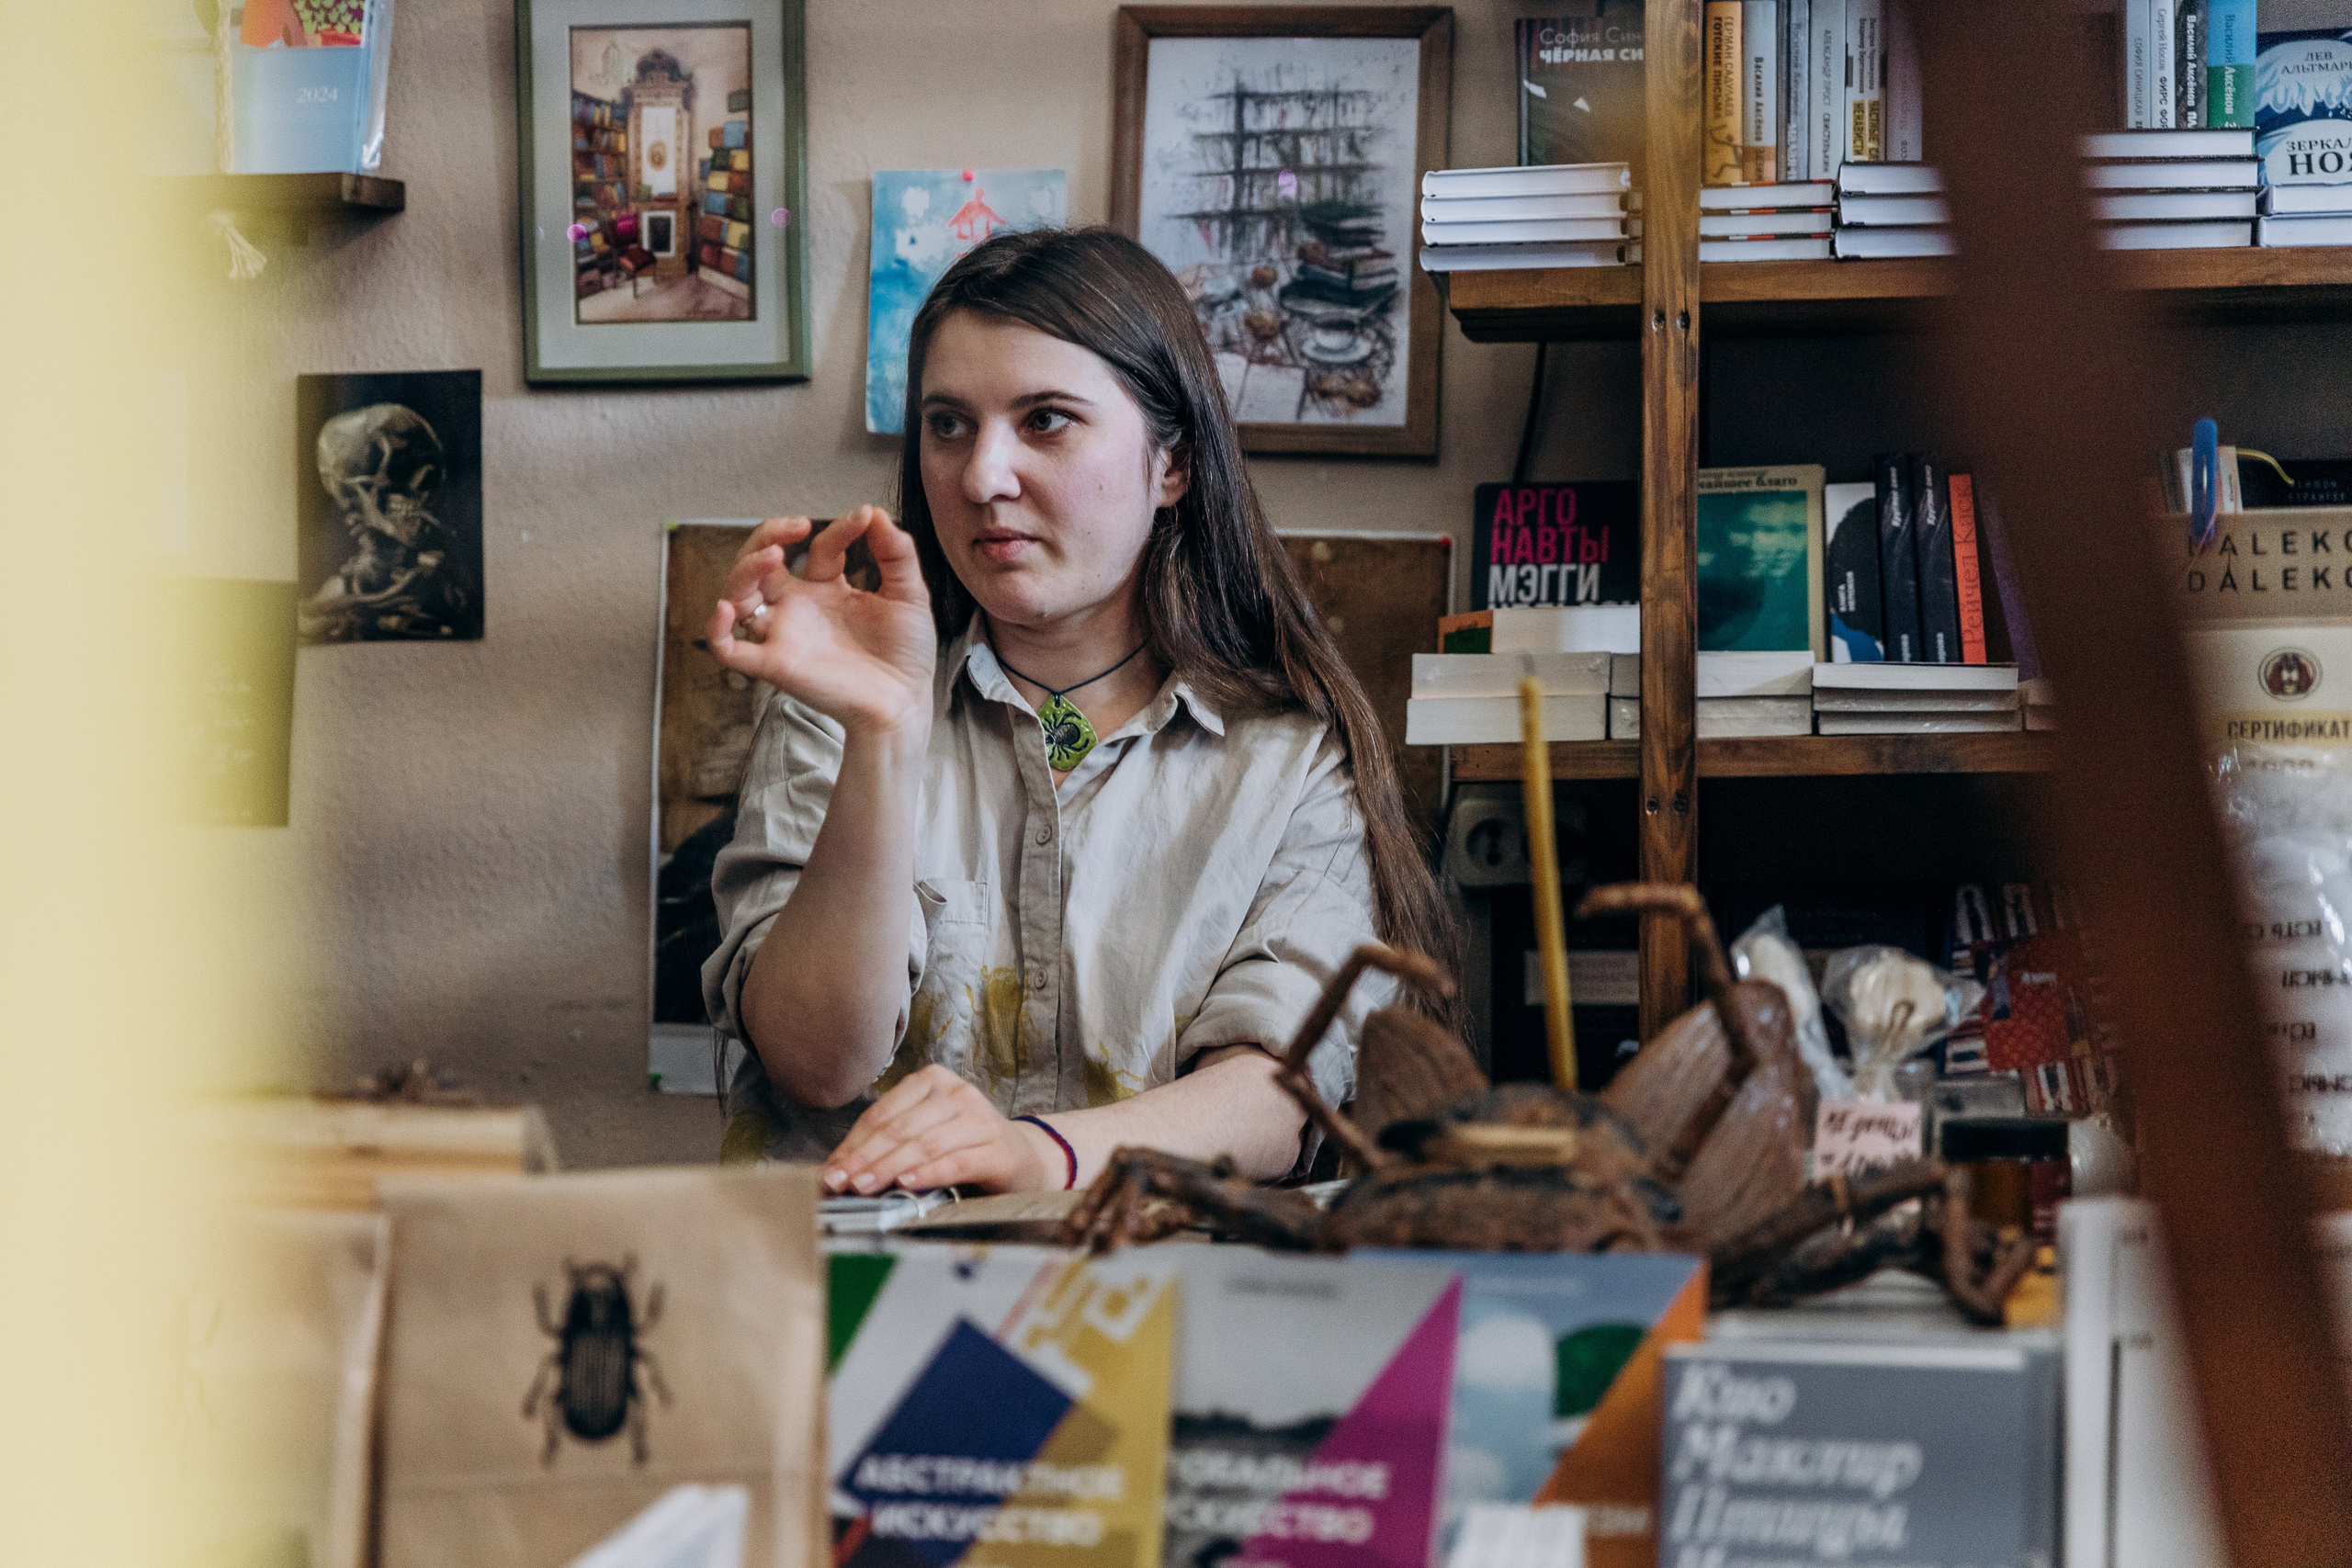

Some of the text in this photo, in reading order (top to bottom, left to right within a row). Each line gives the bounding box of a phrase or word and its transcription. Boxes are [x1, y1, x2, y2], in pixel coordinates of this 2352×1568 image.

[1539, 27, 1600, 48] София
[1539, 47, 1615, 63] ЧЁРНАЯ
[2133, 38, 2143, 67] СОФИЯ
[2224, 15, 2236, 62] Василий
[2305, 51, 2334, 62] ЛЕВ
[1713, 17, 1724, 119] ГОТСКИЕ ПИСЬМА
[1724, 17, 1735, 117] ГЕРМАН САДУЛАЕВ
[2187, 15, 2198, 129] Василий Аксёнов ПЛ
[296, 86, 339, 103] 2024
[2133, 69, 2143, 116] СИНИЦКАЯ
[2159, 76, 2168, 105] ФИРС
[2224, 66, 2236, 115] Аксёнов
[1853, 102, 1864, 155] НЕНАВИСТИ
[2289, 151, 2352, 176] НО
[1493, 488, 1576, 525] АРГО
[1490, 525, 1610, 564] НАВТЫ
[1487, 563, 1600, 603] МЭГГИ
[1960, 555, 1984, 645] Рейчел
[2226, 720, 2350, 739] СЕРТИФИКАТ
